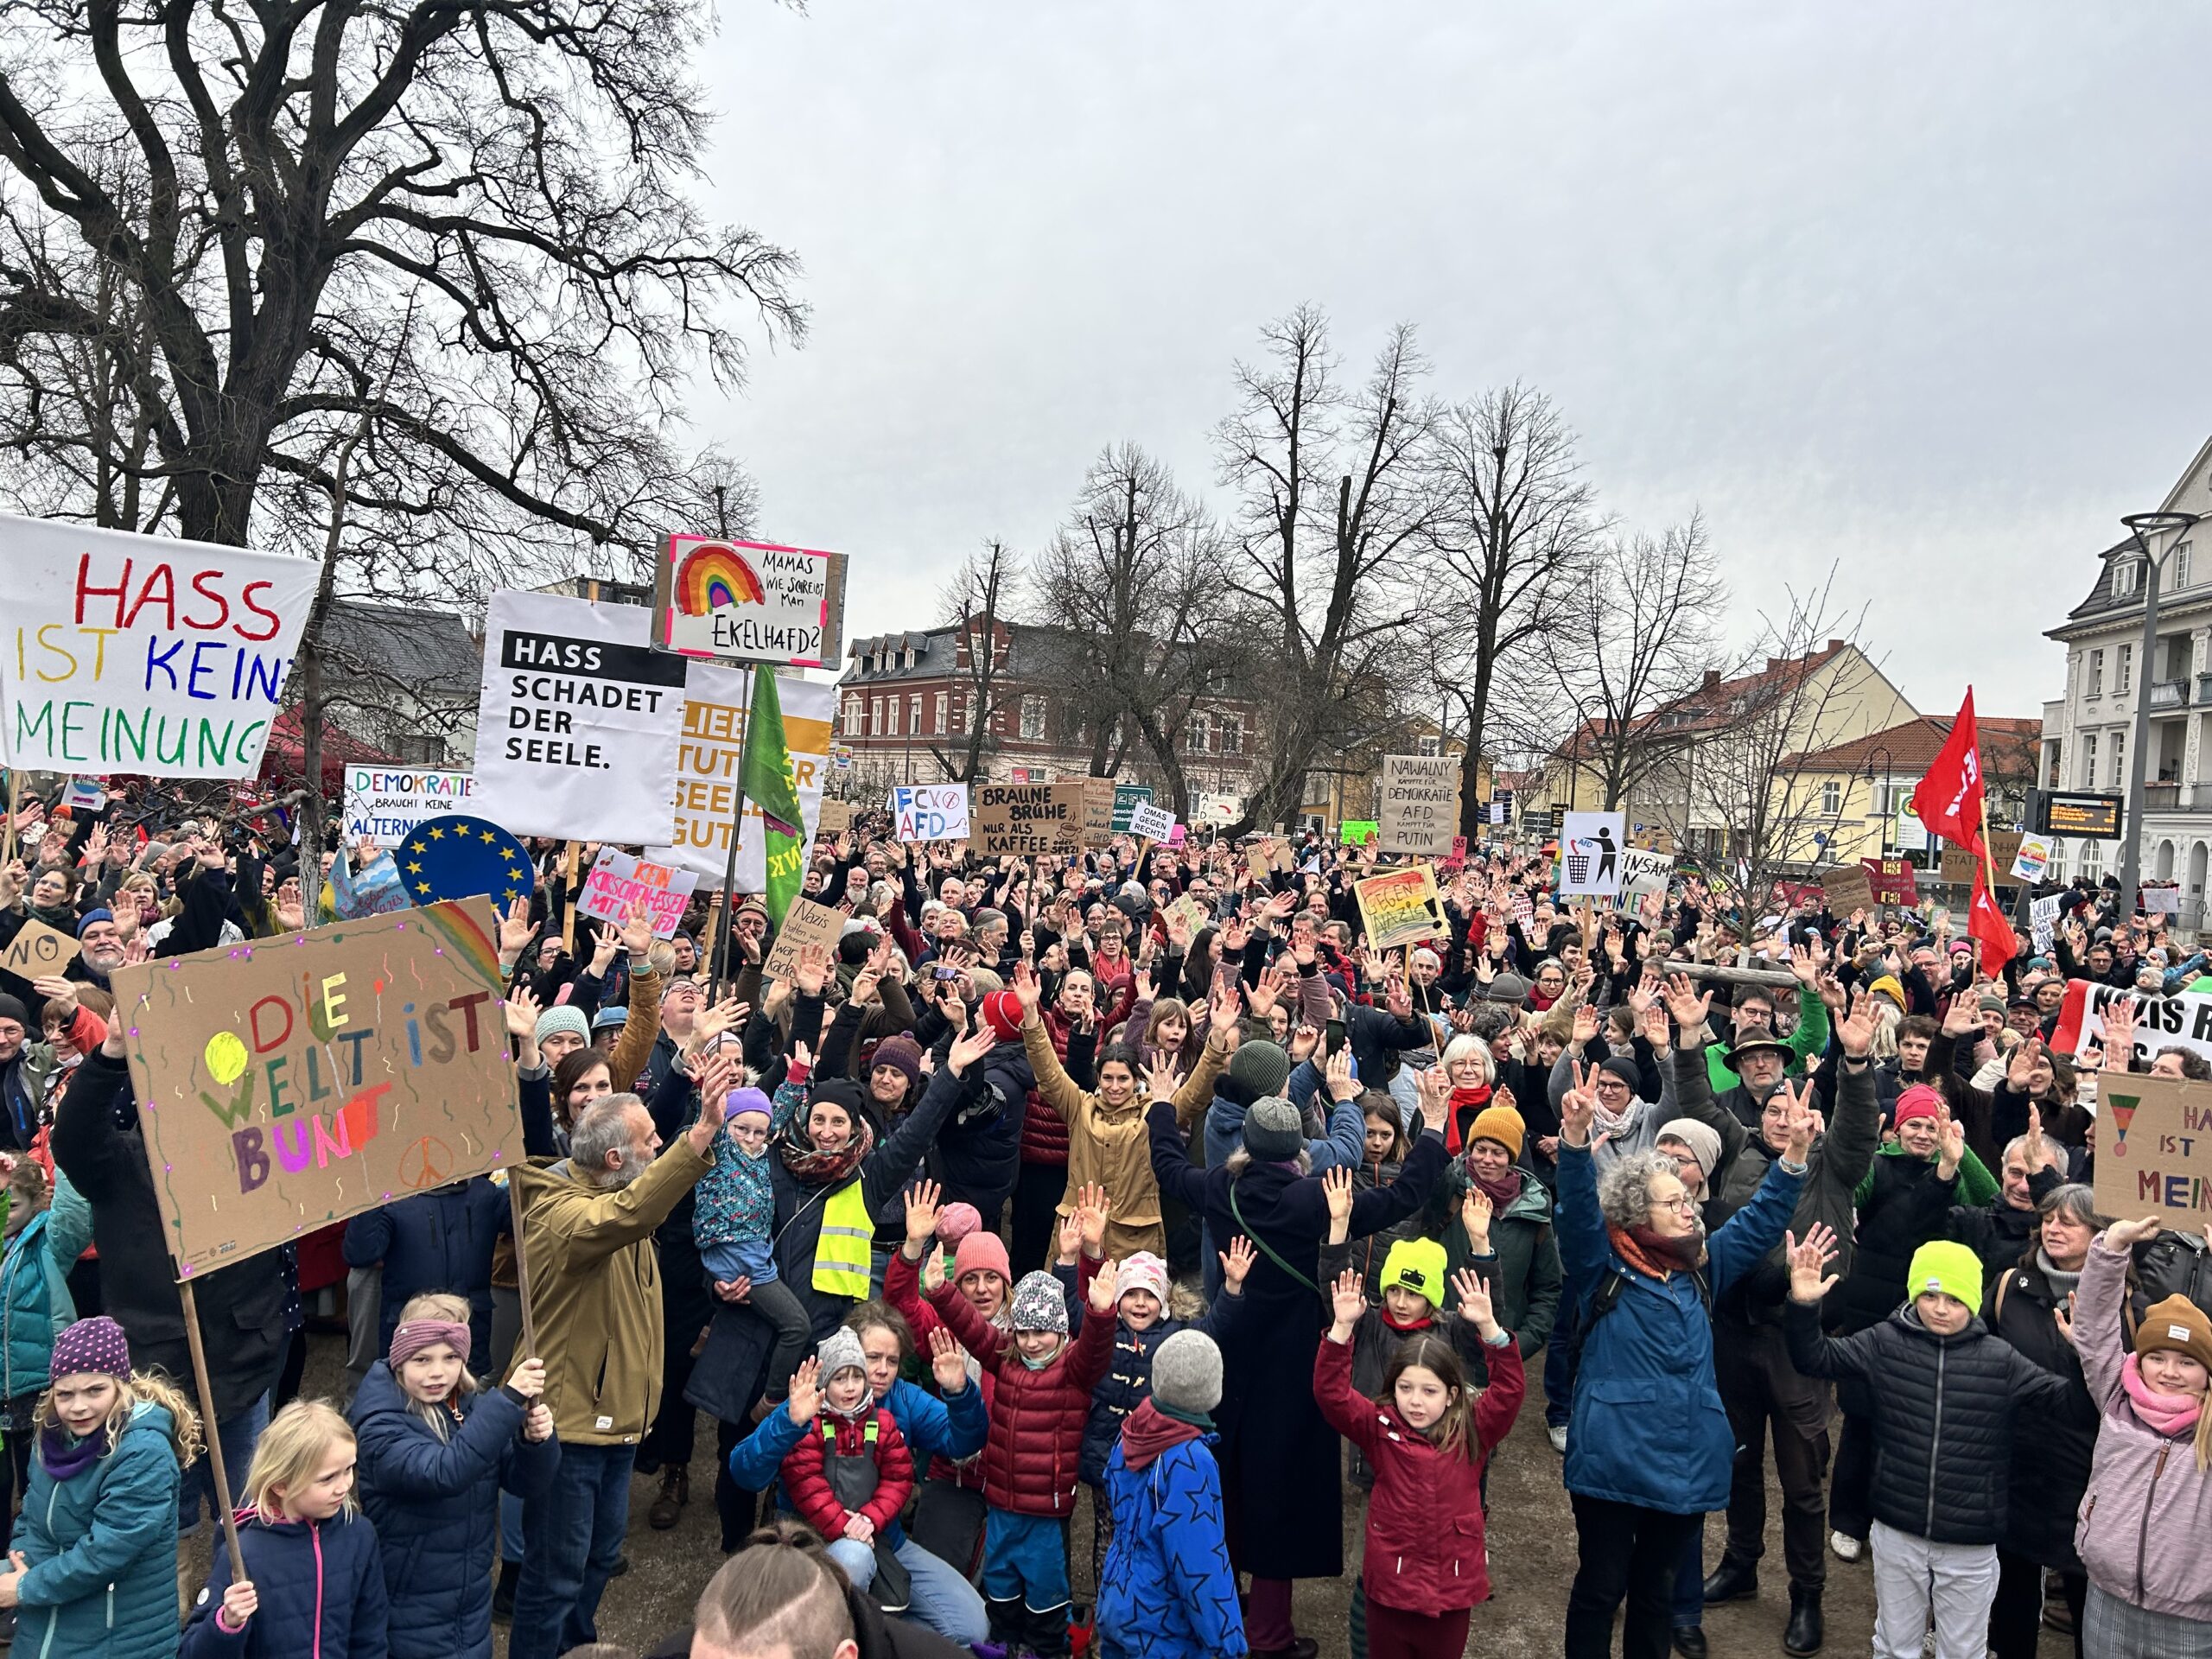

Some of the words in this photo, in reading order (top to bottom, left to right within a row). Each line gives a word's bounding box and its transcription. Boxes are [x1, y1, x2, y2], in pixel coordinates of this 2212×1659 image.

[763, 551, 813, 574] MAMAS
[766, 574, 784, 590] WIE
[75, 553, 280, 641] HASS
[711, 614, 820, 654] EKELHAFD?
[16, 624, 118, 682] IST
[514, 638, 601, 671] HASS
[512, 676, 663, 714] SCHADET
[508, 705, 572, 734] DER
[505, 737, 610, 769] SEELE.
[679, 744, 740, 778] TUT
[1391, 760, 1452, 776] NAWALNY
[357, 772, 473, 797] DEMOKRATIE
[1424, 777, 1437, 785] FÜR
[376, 798, 418, 809] BRAUCHT
[425, 799, 453, 810] KEINE
[895, 788, 941, 812] FCK
[982, 786, 1052, 806] BRAUNE
[1009, 803, 1067, 821] BRÜHE
[1139, 816, 1167, 830] GEGEN
[1143, 807, 1167, 821] OMAS
[1402, 805, 1433, 819] AFD
[352, 818, 428, 836] ALTERN
[672, 817, 742, 851] GUT.
[899, 811, 945, 840] AFD
[983, 822, 1005, 834] NUR
[1010, 823, 1033, 835] ALS
[1135, 823, 1166, 840] RECHTS
[988, 836, 1048, 852] KAFFEE
[1050, 845, 1079, 855] SPEZI
[1577, 838, 1593, 849] AfD
[632, 861, 674, 888] KEIN
[588, 893, 620, 915] MIT
[1363, 881, 1414, 916] GEGEN
[793, 899, 830, 929] Nazis
[785, 918, 807, 938] hatten
[9, 934, 59, 967] NO
[775, 942, 798, 957] war
[200, 1027, 373, 1129] WELT
[232, 1081, 393, 1195] BUNT
[2160, 1135, 2196, 1157] IST
